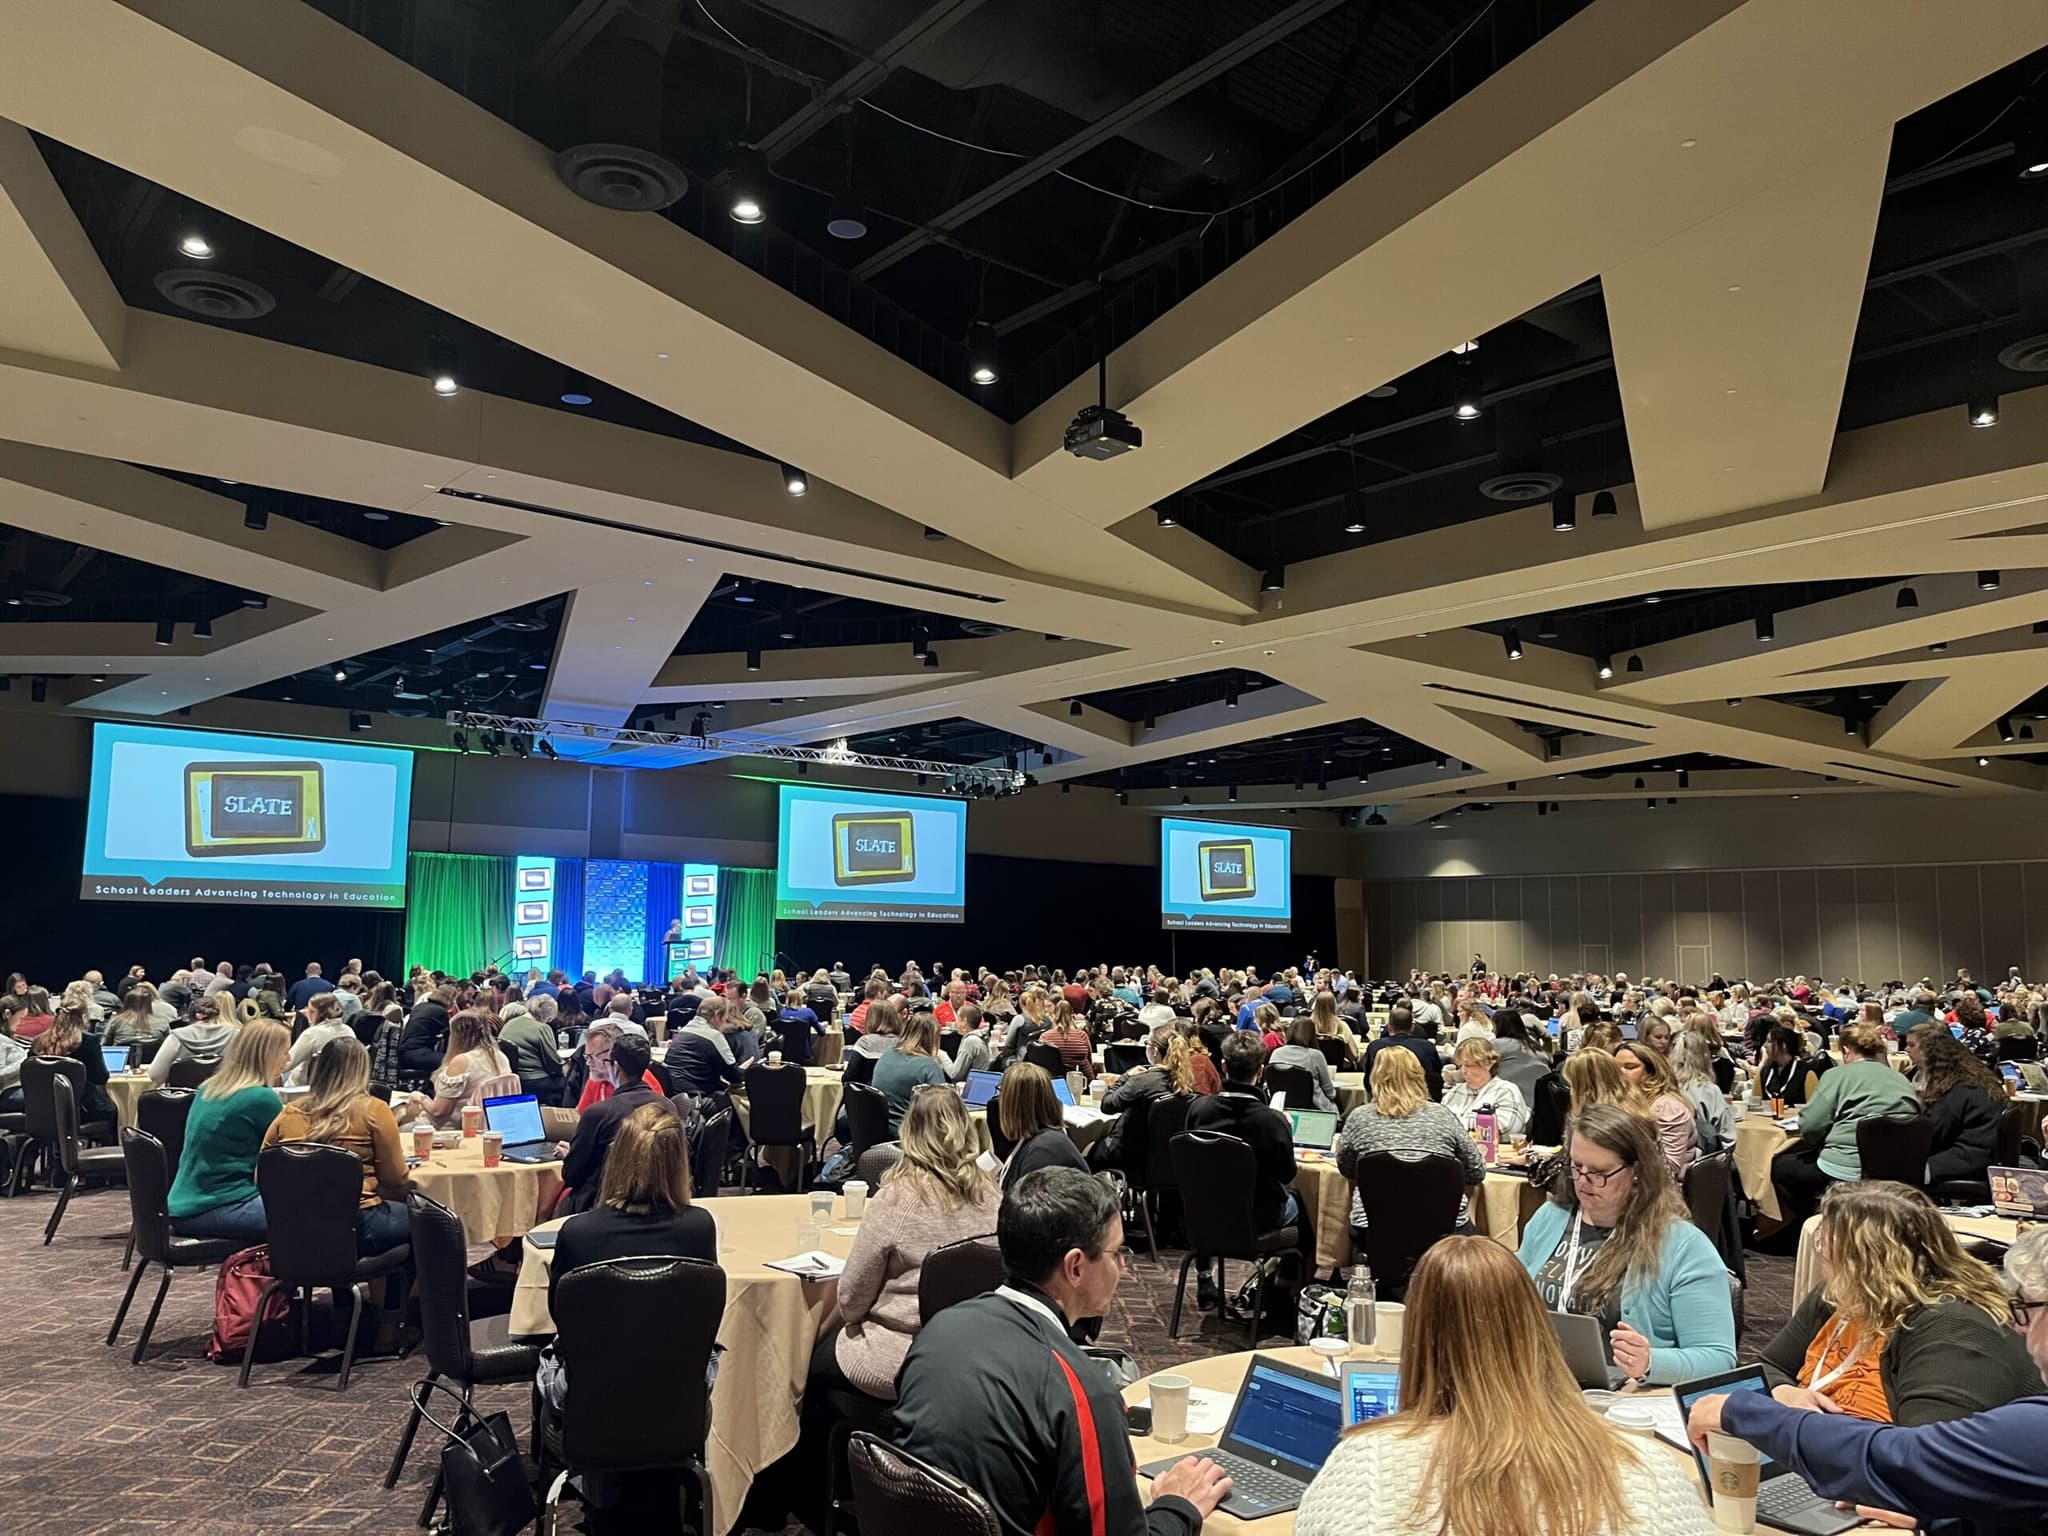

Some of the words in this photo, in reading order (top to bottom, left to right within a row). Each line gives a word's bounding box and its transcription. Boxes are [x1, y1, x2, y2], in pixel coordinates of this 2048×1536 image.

[224, 795, 293, 816] SLATE
[855, 838, 896, 854] SLATE
[1214, 862, 1243, 874] SLATE
[95, 885, 138, 895] School
[142, 887, 191, 896] Leaders
[195, 888, 258, 899] Advancing
[262, 890, 325, 900] Technology
[343, 892, 396, 902] Education
[840, 910, 878, 918] Advancing
[927, 911, 959, 919] Education
